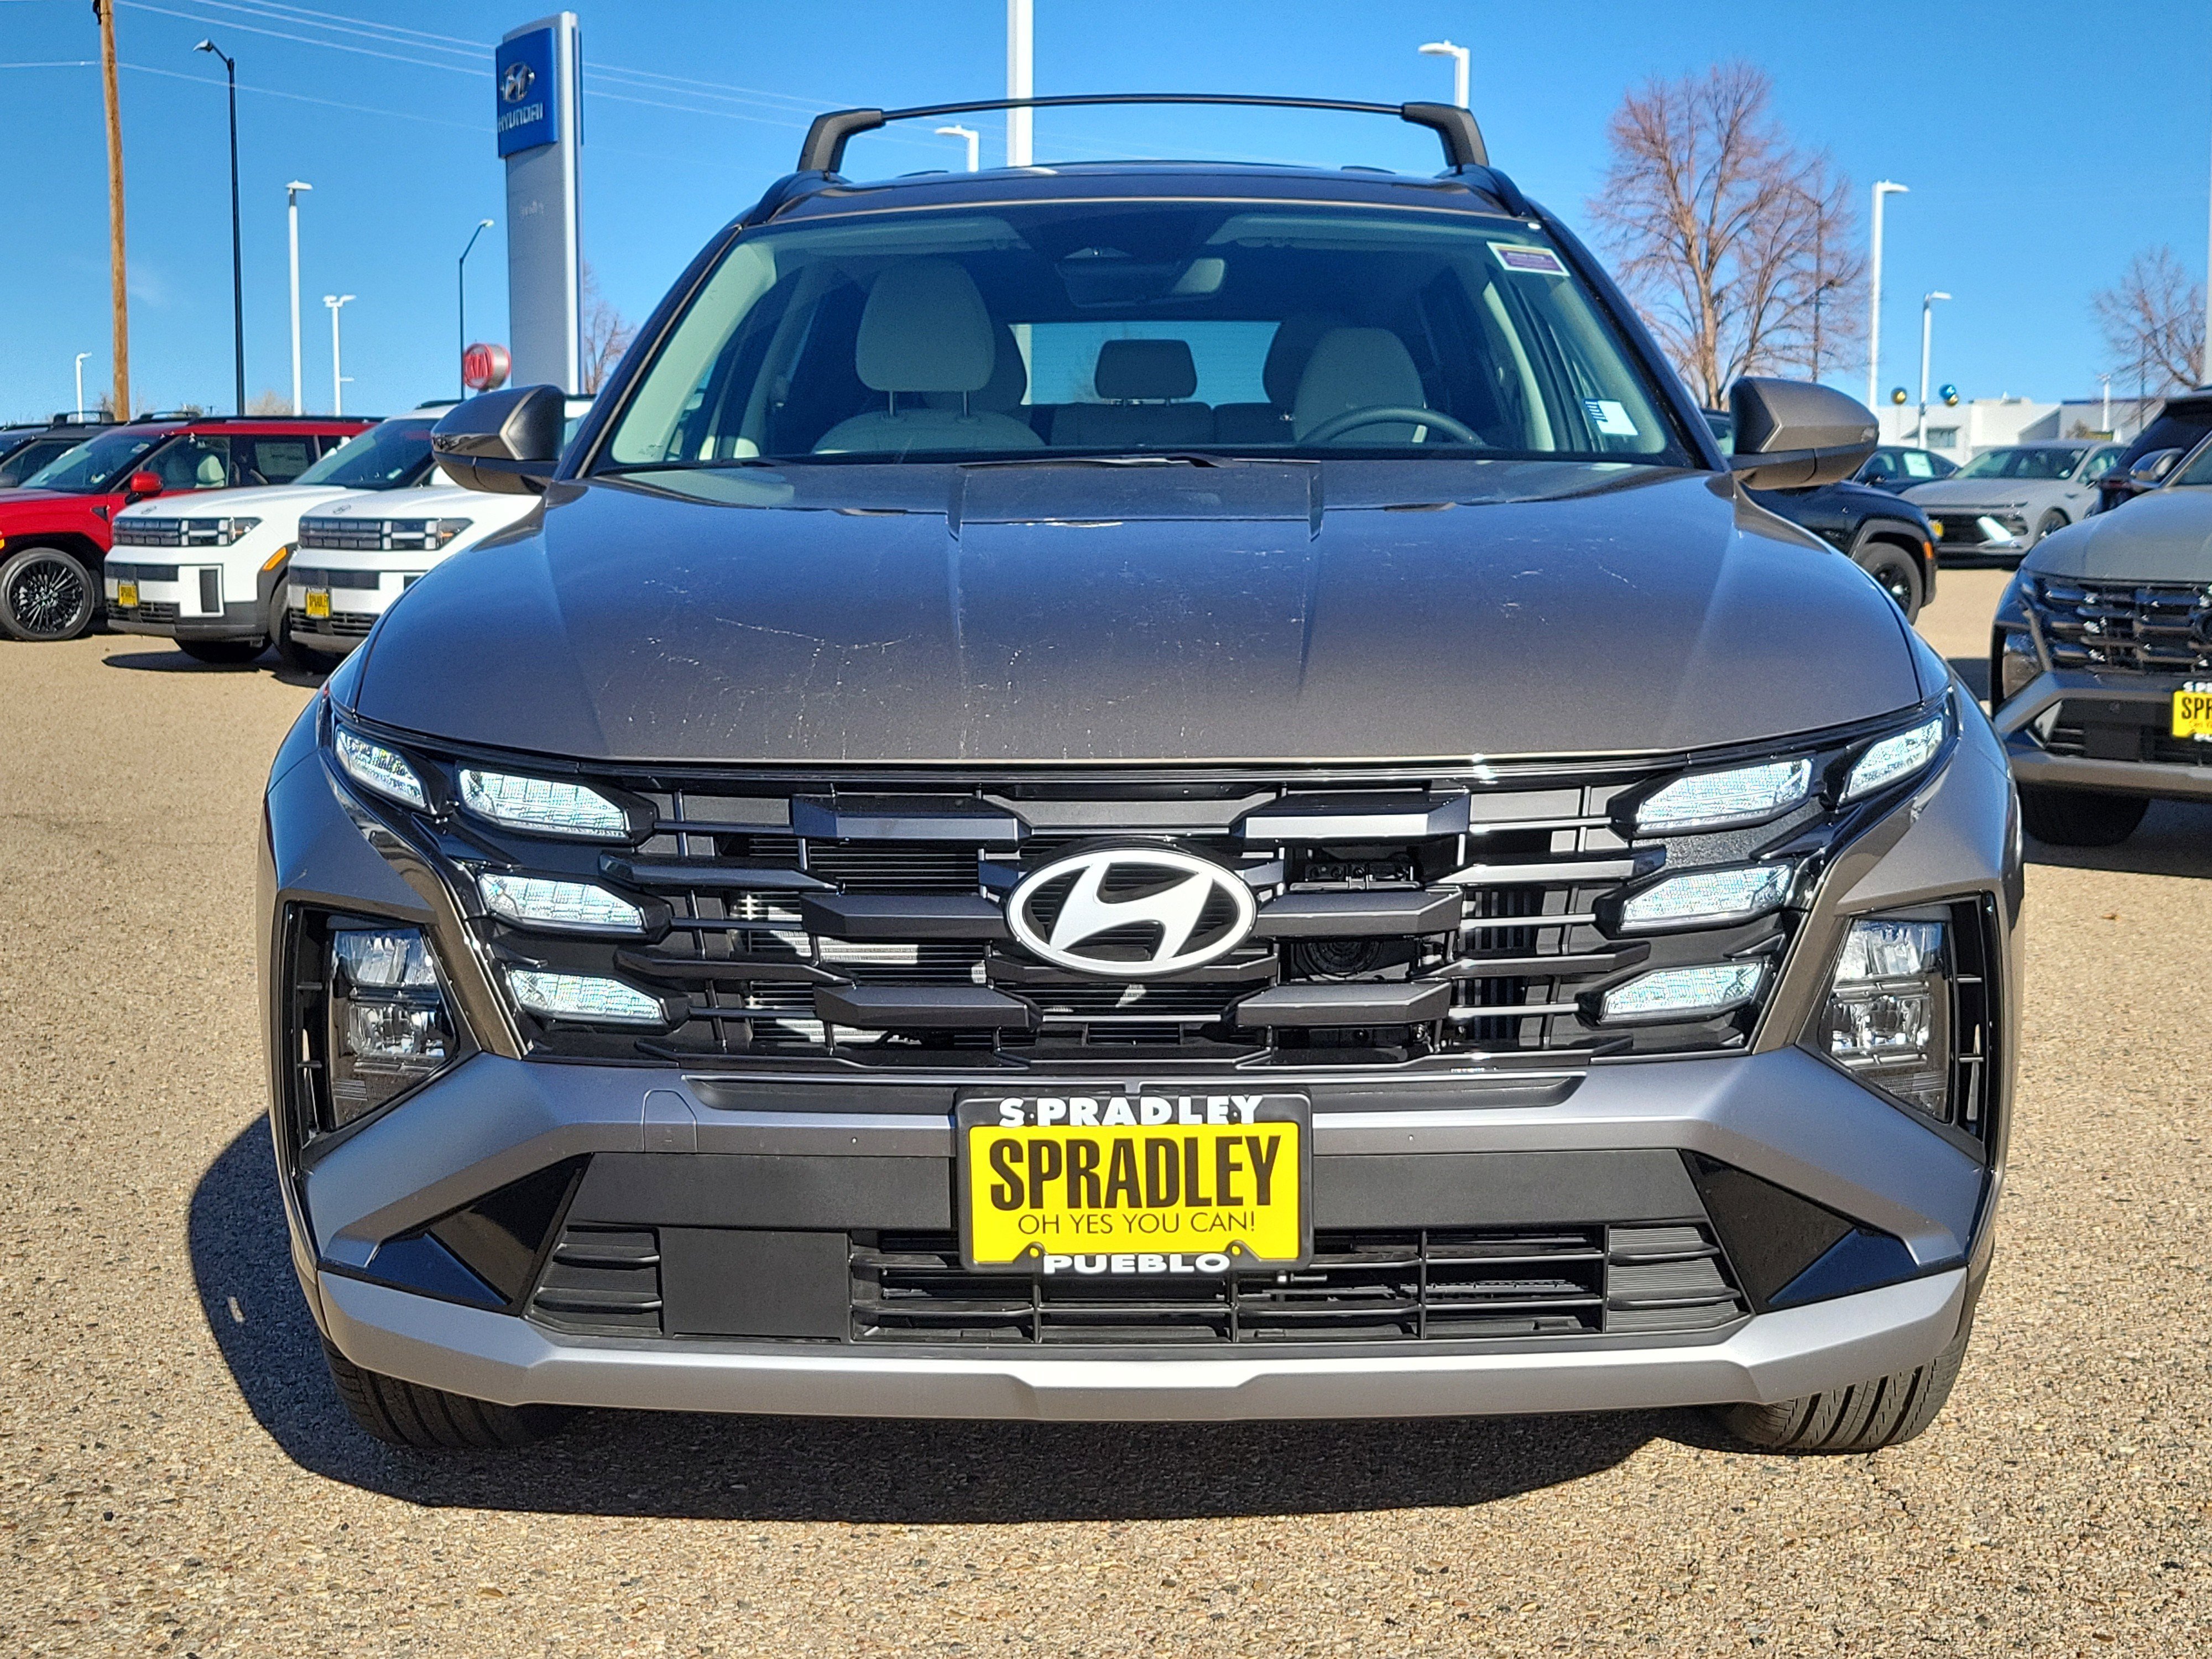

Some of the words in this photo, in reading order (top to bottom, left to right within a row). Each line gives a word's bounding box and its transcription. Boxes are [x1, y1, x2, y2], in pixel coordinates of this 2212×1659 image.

[498, 103, 543, 133] HYUNDAI
[999, 1095, 1263, 1128] SPRADLEY
[989, 1135, 1281, 1211] SPRADLEY
[1018, 1214, 1060, 1234] OH
[1069, 1214, 1113, 1234] YES
[1121, 1213, 1179, 1234] YOU
[1191, 1211, 1254, 1233] CAN!
[1044, 1253, 1230, 1274] PUEBLO
